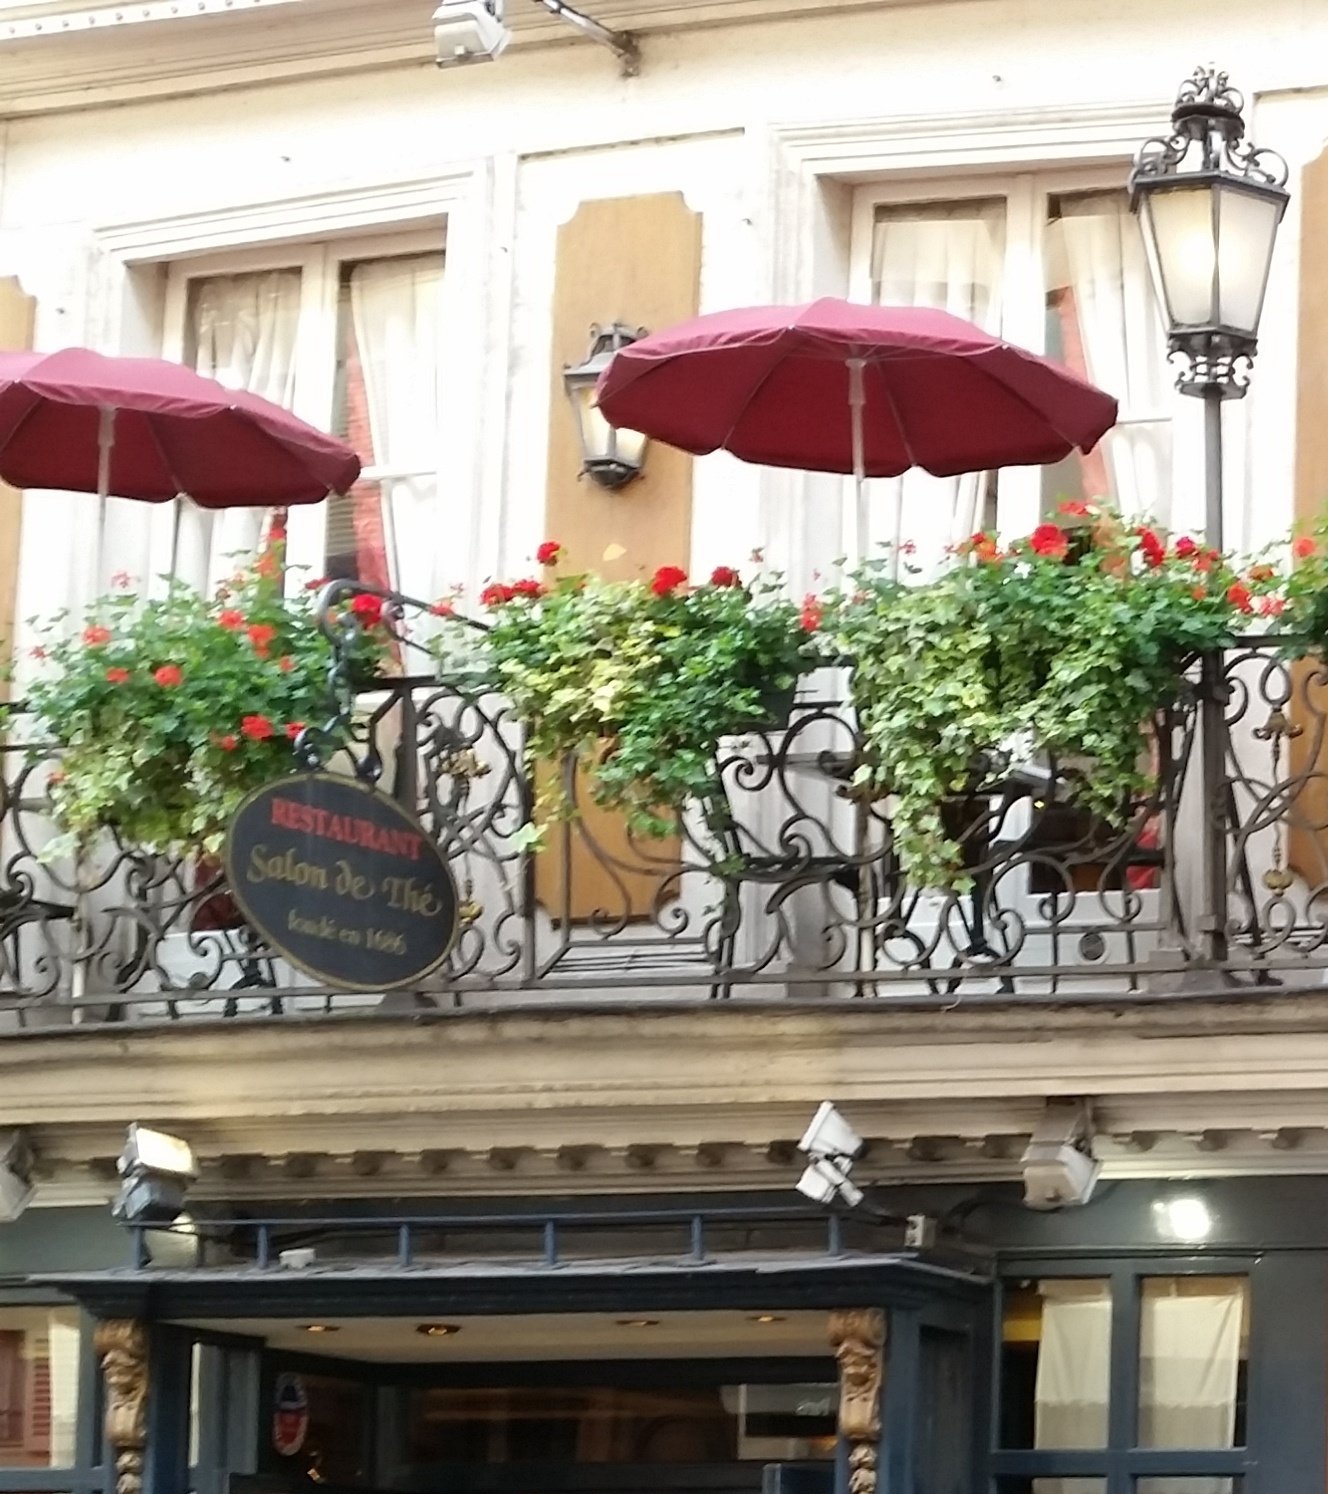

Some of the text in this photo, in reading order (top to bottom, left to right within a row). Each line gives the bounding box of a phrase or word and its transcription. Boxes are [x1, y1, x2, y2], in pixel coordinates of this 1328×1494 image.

[271, 797, 424, 861] RESTAURANT
[247, 844, 443, 917] Salon de Thé
